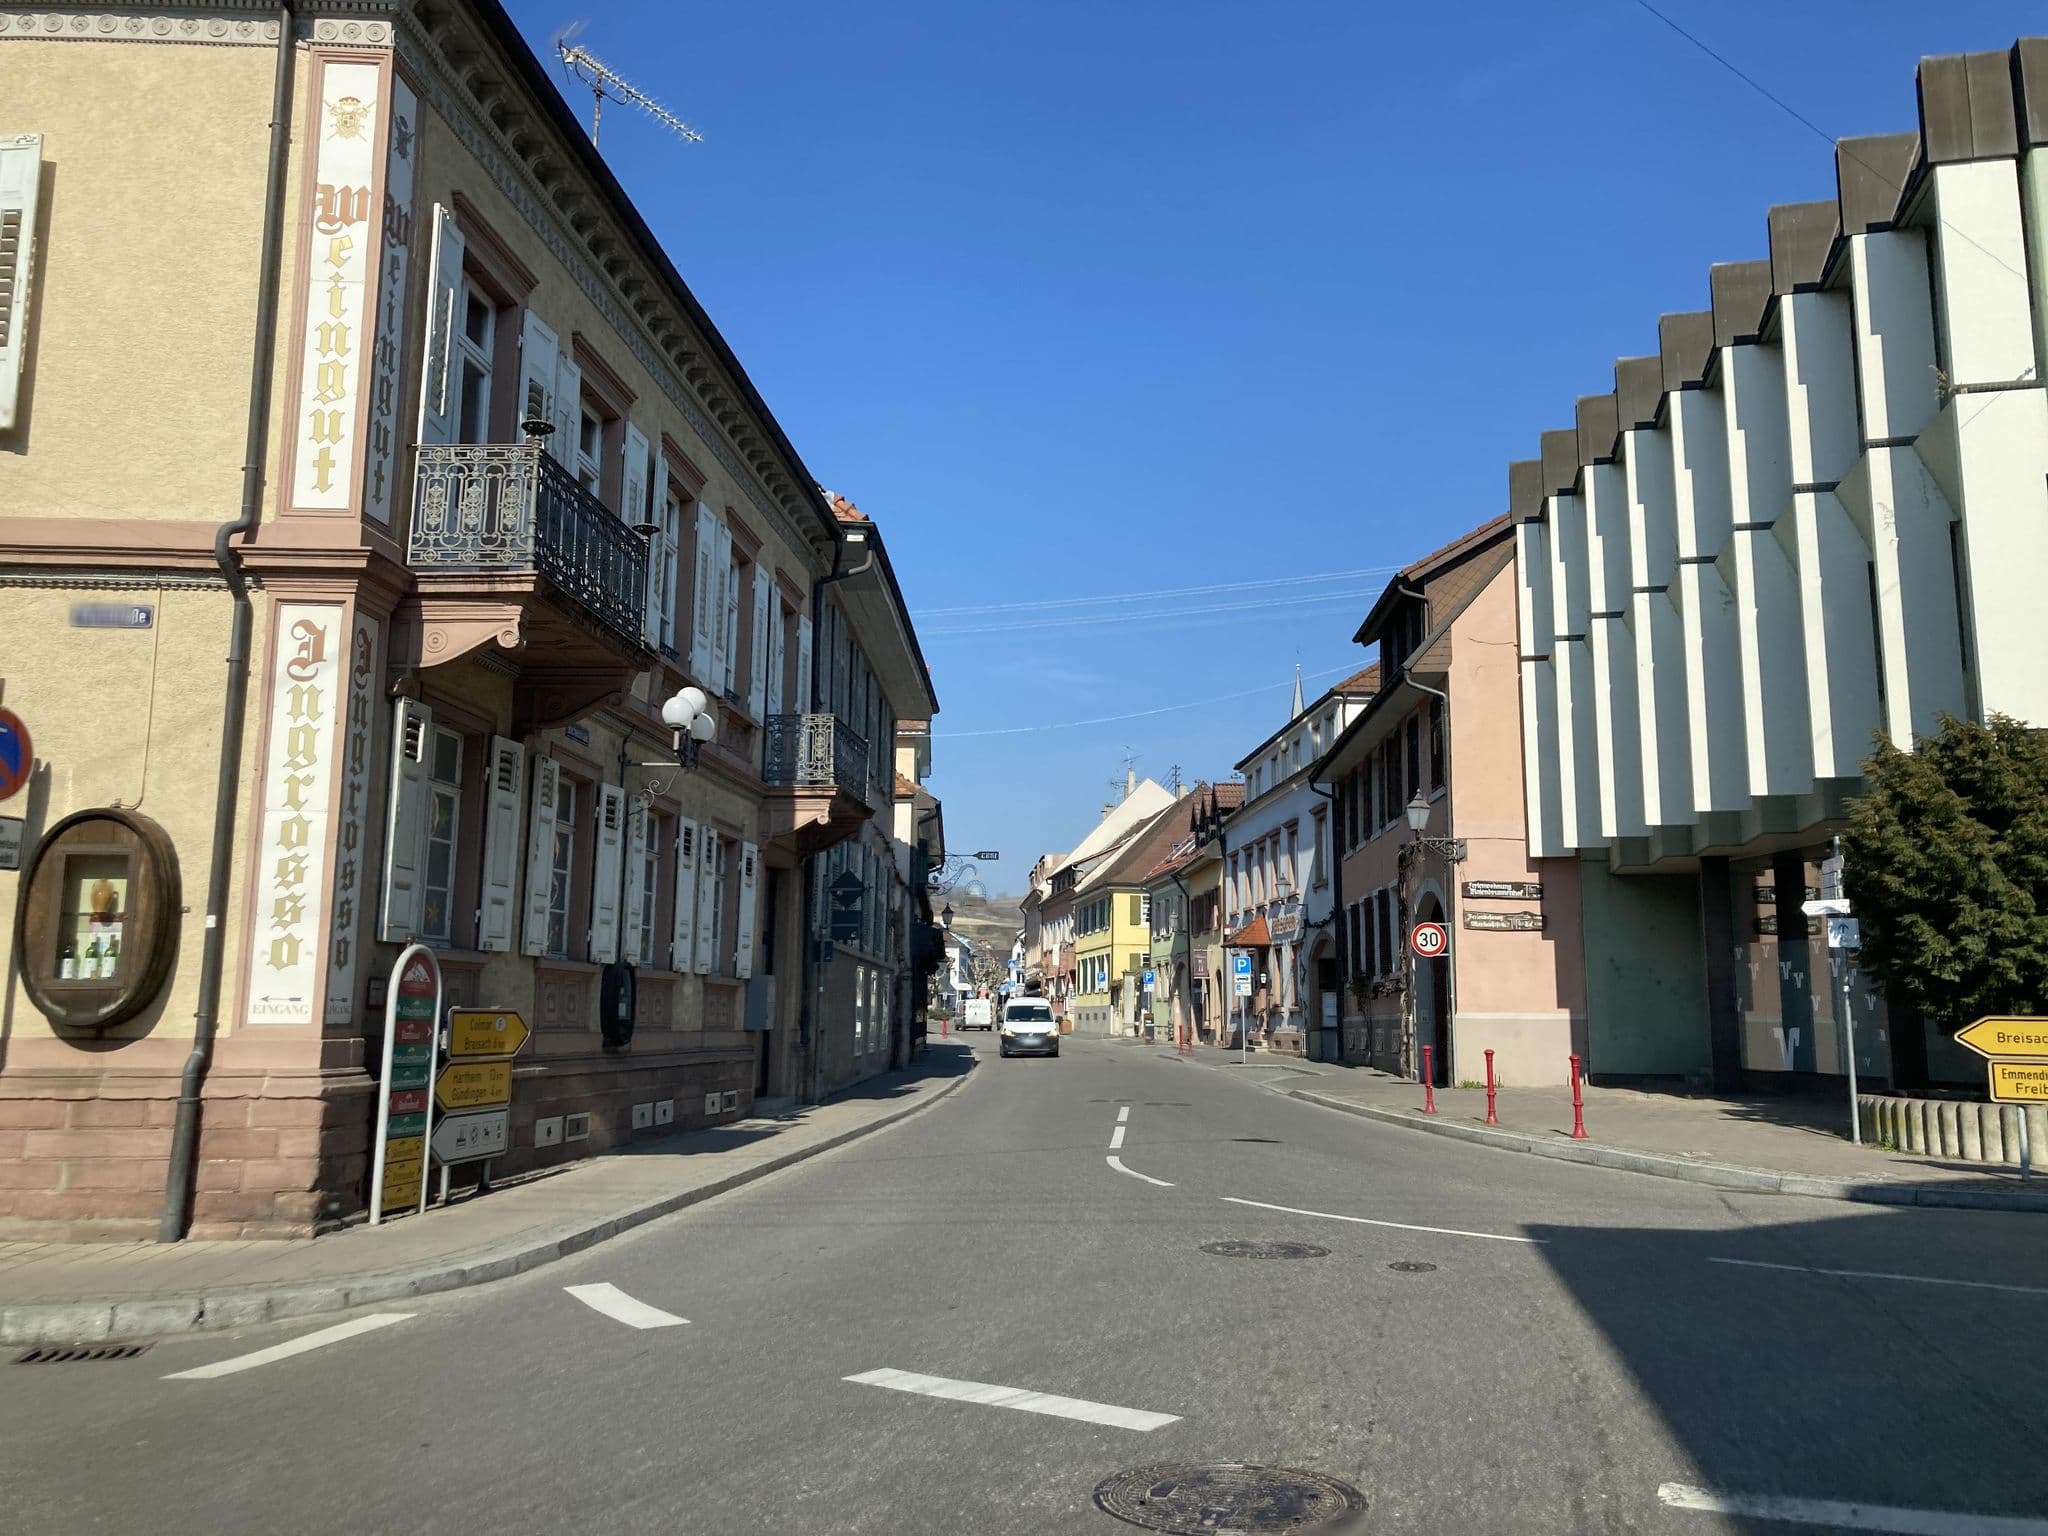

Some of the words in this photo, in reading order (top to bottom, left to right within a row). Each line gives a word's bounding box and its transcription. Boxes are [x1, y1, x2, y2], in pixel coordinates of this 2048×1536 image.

[309, 184, 373, 494] Weingut
[371, 193, 412, 505] Weingut
[252, 1004, 310, 1015] EINGANG
[1419, 932, 1439, 947] 30
